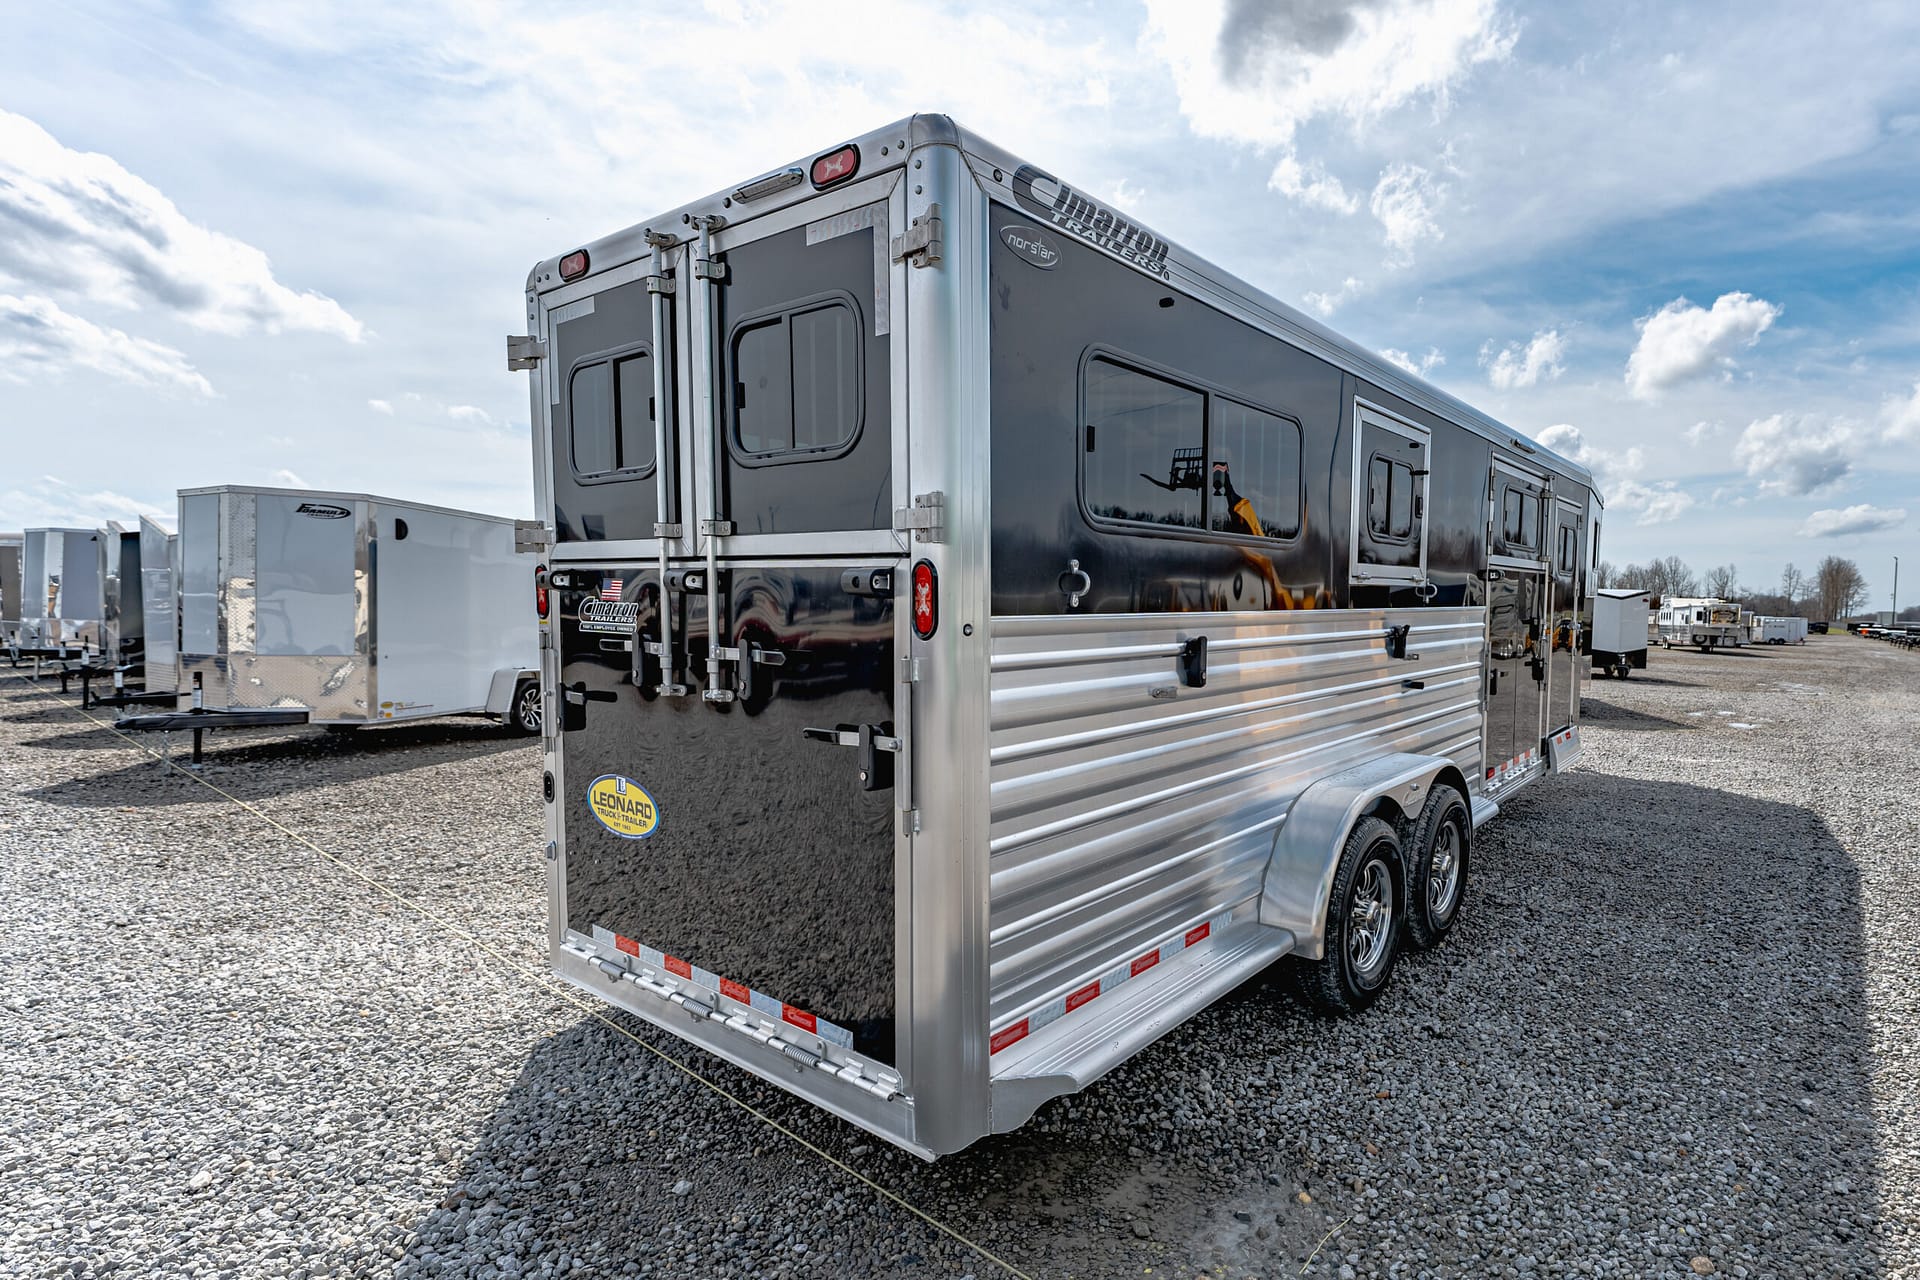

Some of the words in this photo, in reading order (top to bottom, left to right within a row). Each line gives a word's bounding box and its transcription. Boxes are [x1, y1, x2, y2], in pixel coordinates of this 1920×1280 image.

[1012, 164, 1169, 264] Cimarron
[1007, 233, 1055, 260] norstar
[1051, 211, 1162, 273] TRAILERS
[578, 596, 639, 622] Cimarron
[590, 615, 634, 623] TRAILERS
[593, 790, 652, 819] LEONARD
[597, 807, 617, 819] TRUCK
[621, 814, 647, 828] TRAILER
